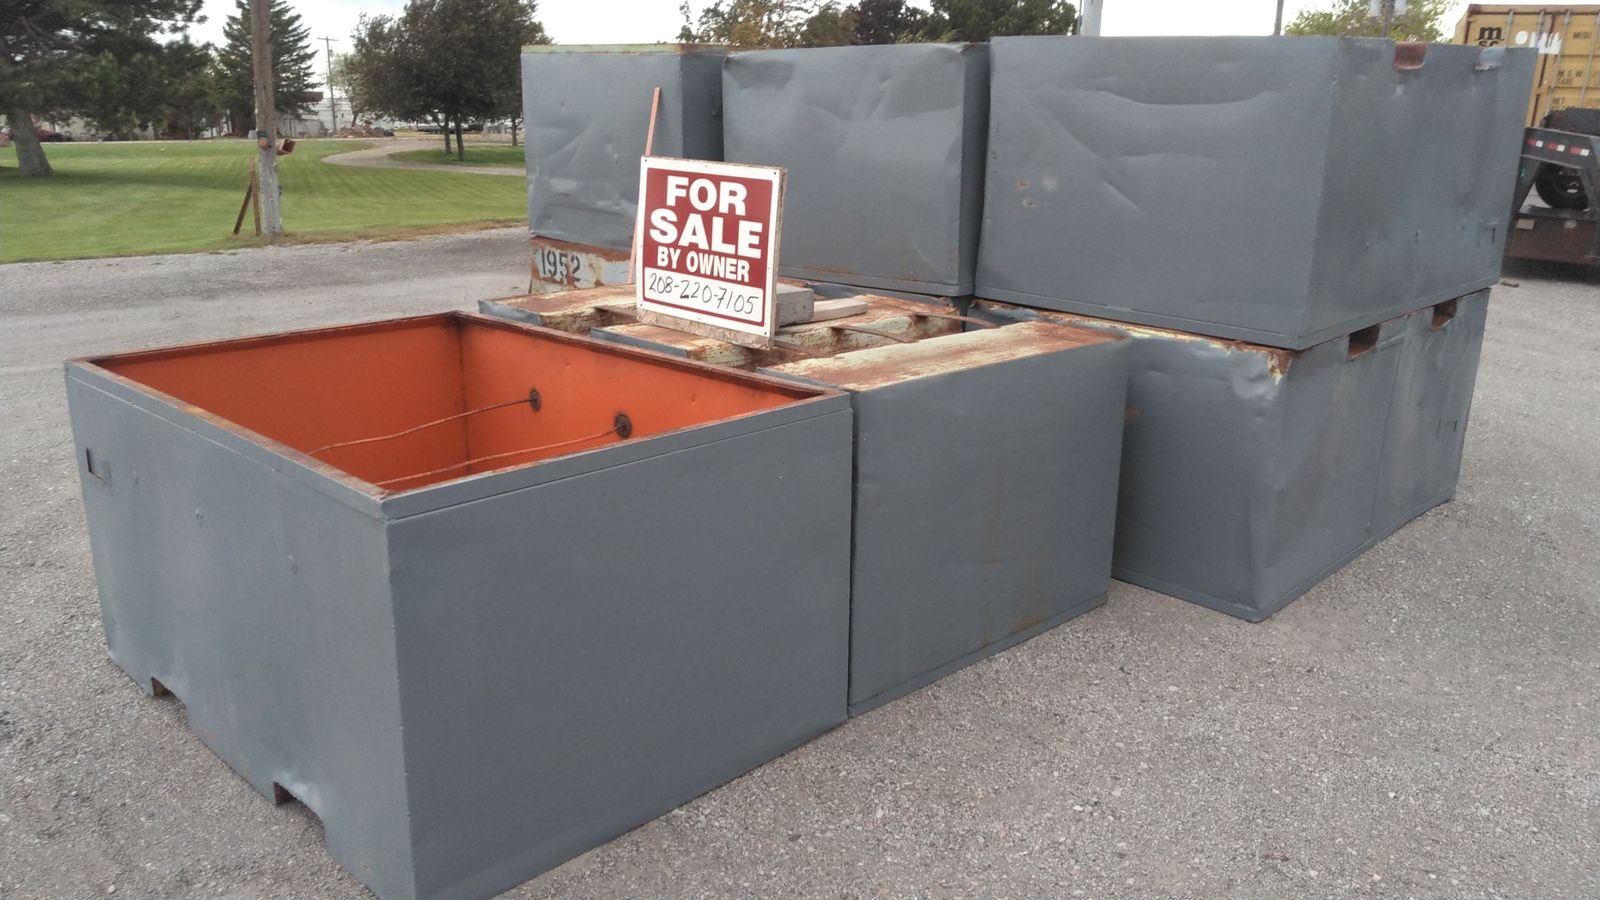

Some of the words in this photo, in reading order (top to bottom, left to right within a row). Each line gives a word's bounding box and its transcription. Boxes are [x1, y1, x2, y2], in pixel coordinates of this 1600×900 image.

[666, 175, 748, 216] FOR
[649, 208, 763, 259] SALE
[541, 248, 581, 282] 1952
[657, 245, 681, 269] BY
[686, 250, 750, 282] OWNER
[649, 272, 759, 314] 208-220-7105
